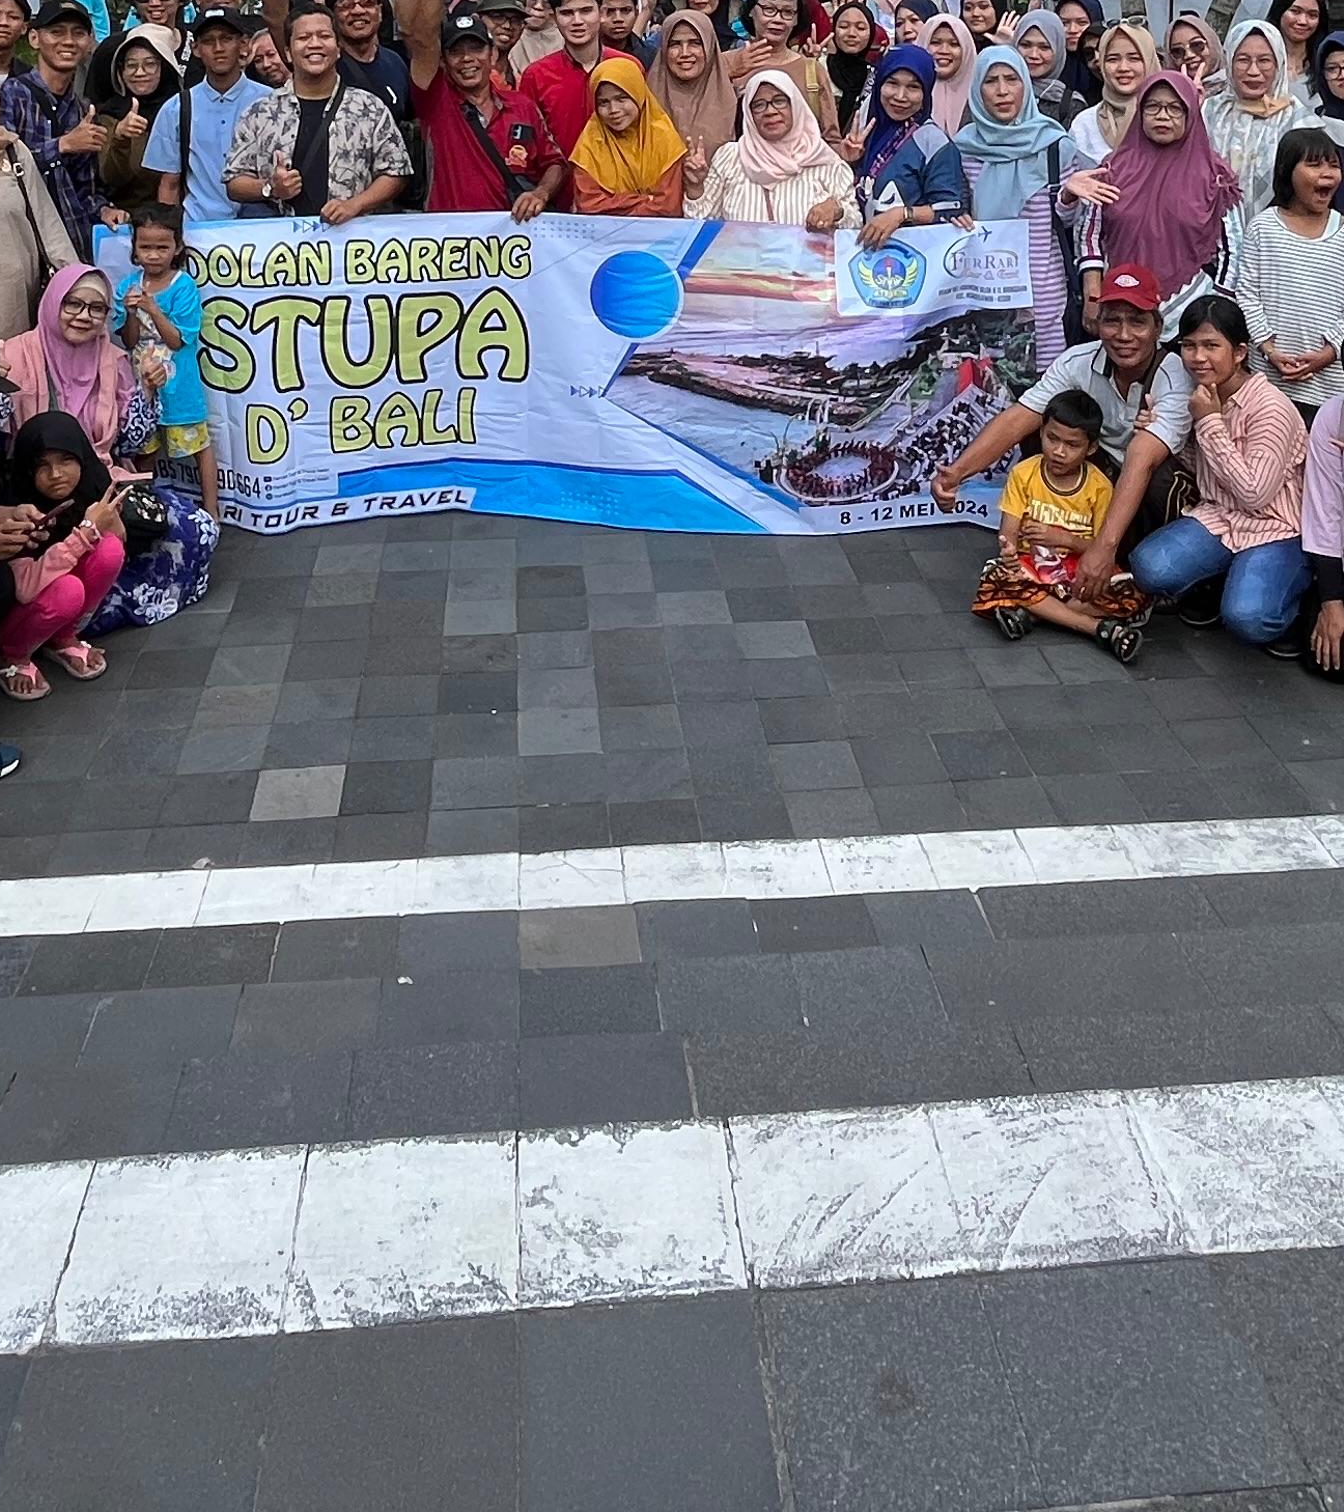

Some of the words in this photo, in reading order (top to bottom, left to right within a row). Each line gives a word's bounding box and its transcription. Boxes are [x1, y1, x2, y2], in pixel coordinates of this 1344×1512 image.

[186, 240, 331, 287] DOLAN
[344, 234, 531, 283] BARENG
[198, 285, 530, 394] STUPA
[329, 386, 476, 453] BALI
[252, 505, 319, 529] TOUR
[331, 502, 350, 517] &
[364, 489, 469, 513] TRAVEL
[840, 511, 851, 525] 8
[870, 507, 893, 521] 12
[899, 502, 935, 519] MEI
[942, 499, 989, 518] 024
